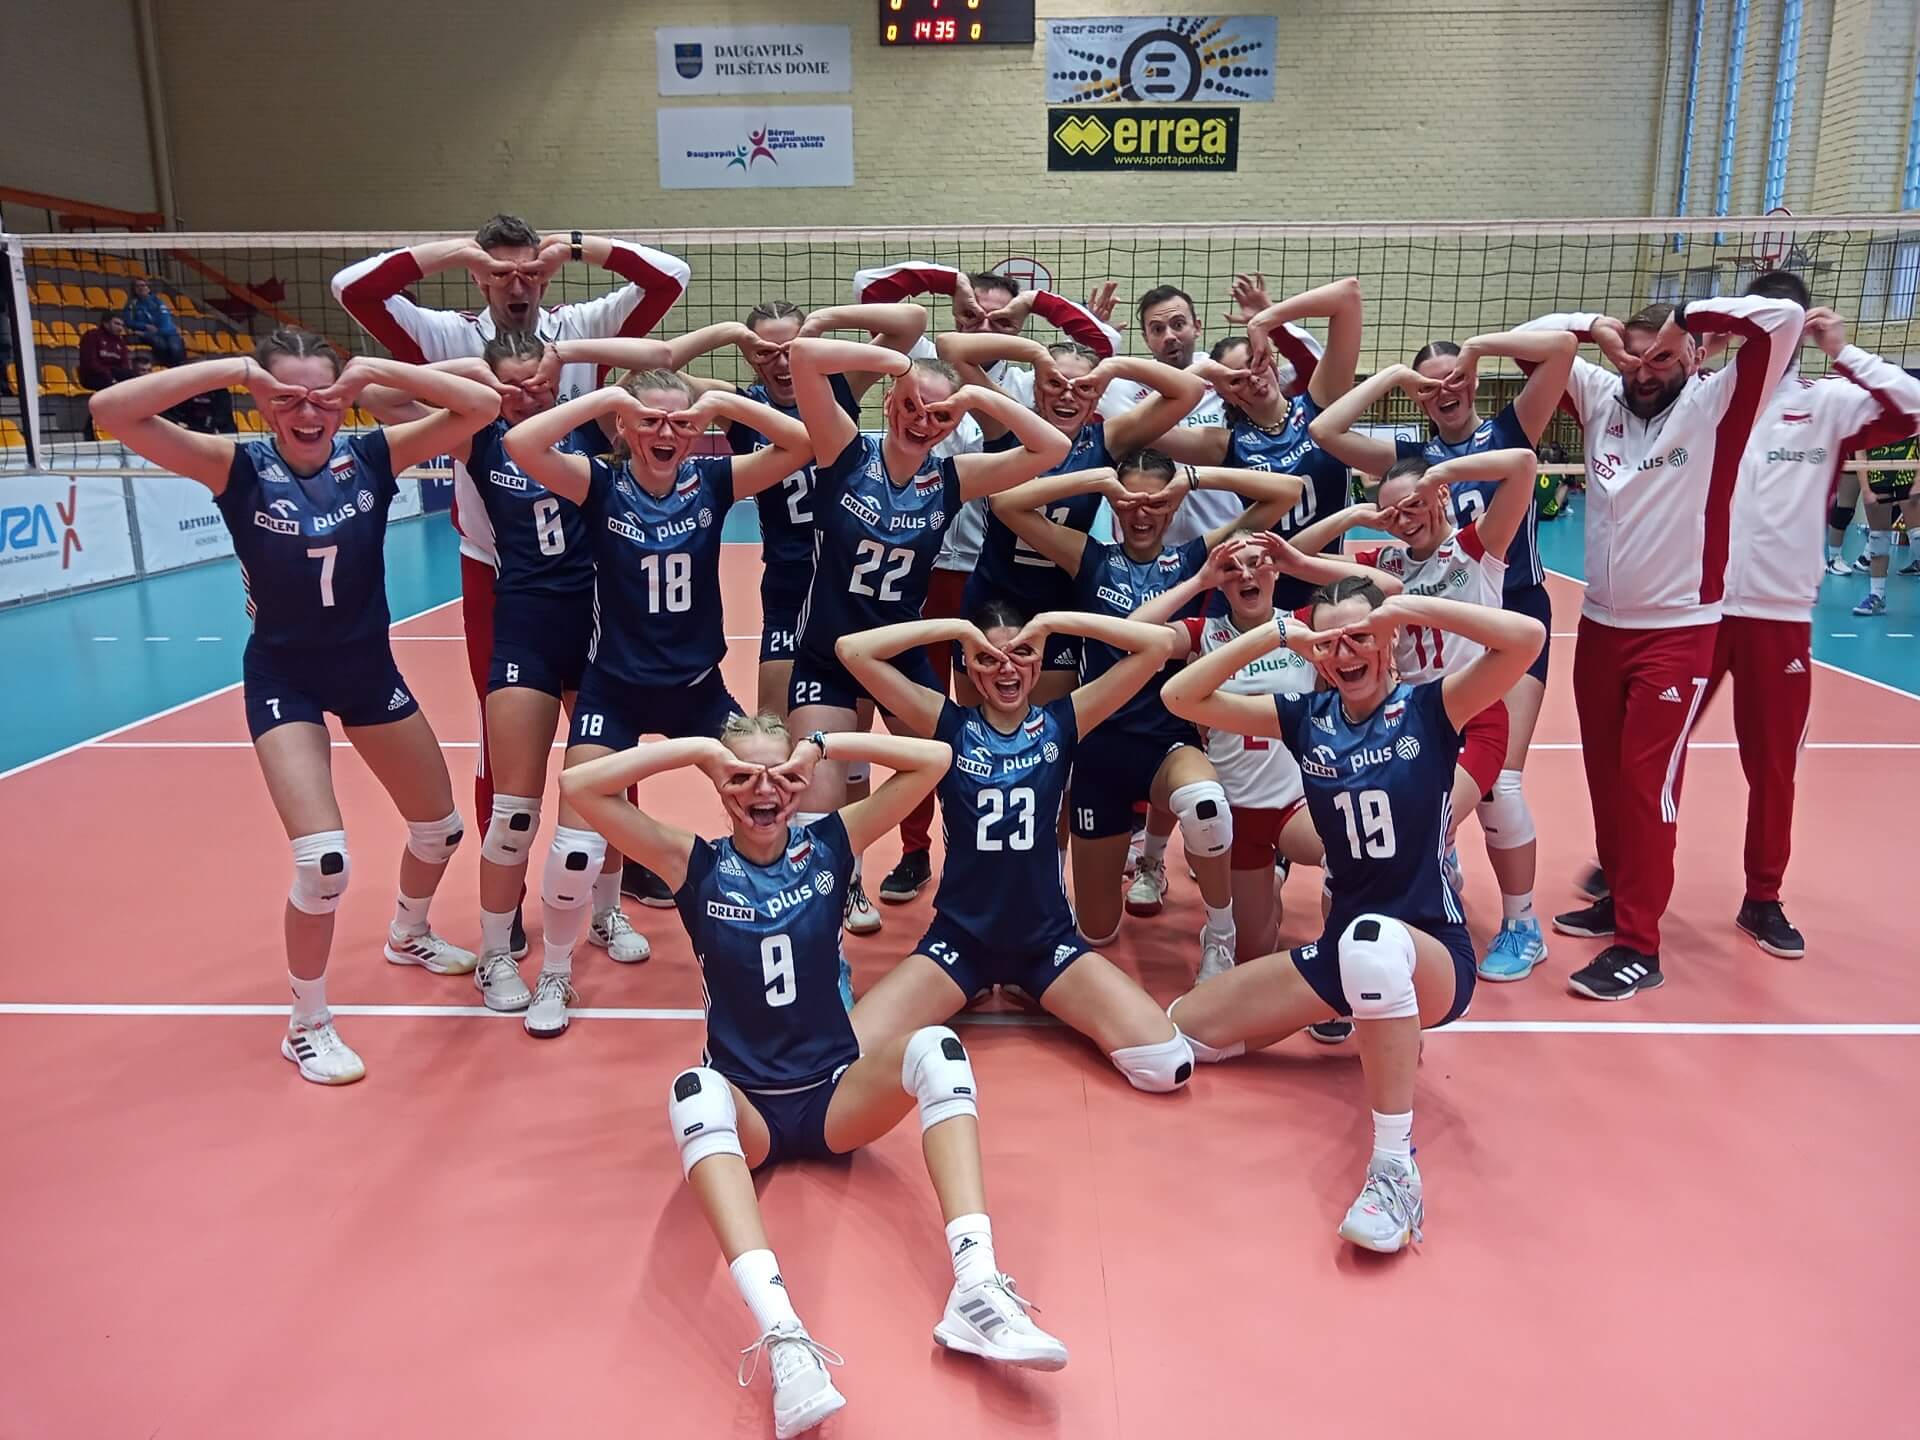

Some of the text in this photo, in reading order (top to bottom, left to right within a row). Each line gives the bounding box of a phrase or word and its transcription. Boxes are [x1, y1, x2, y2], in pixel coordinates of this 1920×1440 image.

[887, 25, 898, 41] 0
[970, 23, 982, 40] 0
[714, 44, 804, 58] DAUGAVPILS
[786, 62, 830, 75] DOME
[1114, 155, 1226, 167] www.sportapunkts.lv
[1187, 413, 1220, 428] plus
[1280, 440, 1313, 468] plus
[1637, 456, 1664, 471] us
[491, 472, 526, 488] ORLEN
[783, 465, 817, 524] 2
[313, 503, 357, 533] plus
[533, 497, 566, 556] 6
[843, 496, 926, 532] ORLEN plus
[609, 517, 697, 543] ORLEN plus
[306, 545, 338, 608] 7
[640, 552, 692, 614] 18
[848, 539, 916, 602] 22
[1100, 588, 1131, 609] ORLEN
[770, 629, 795, 653] 24
[1248, 656, 1288, 676] plus
[795, 680, 822, 704] 22
[266, 698, 281, 720] 7
[580, 712, 604, 737] 18
[1003, 752, 1042, 775] plus
[1350, 746, 1393, 773] plus
[976, 786, 1036, 851] 23
[1077, 806, 1095, 831] 16
[1333, 789, 1397, 860] 19
[708, 884, 813, 920] ORLEN plus
[928, 941, 960, 965] 23
[760, 933, 797, 1008] 9
